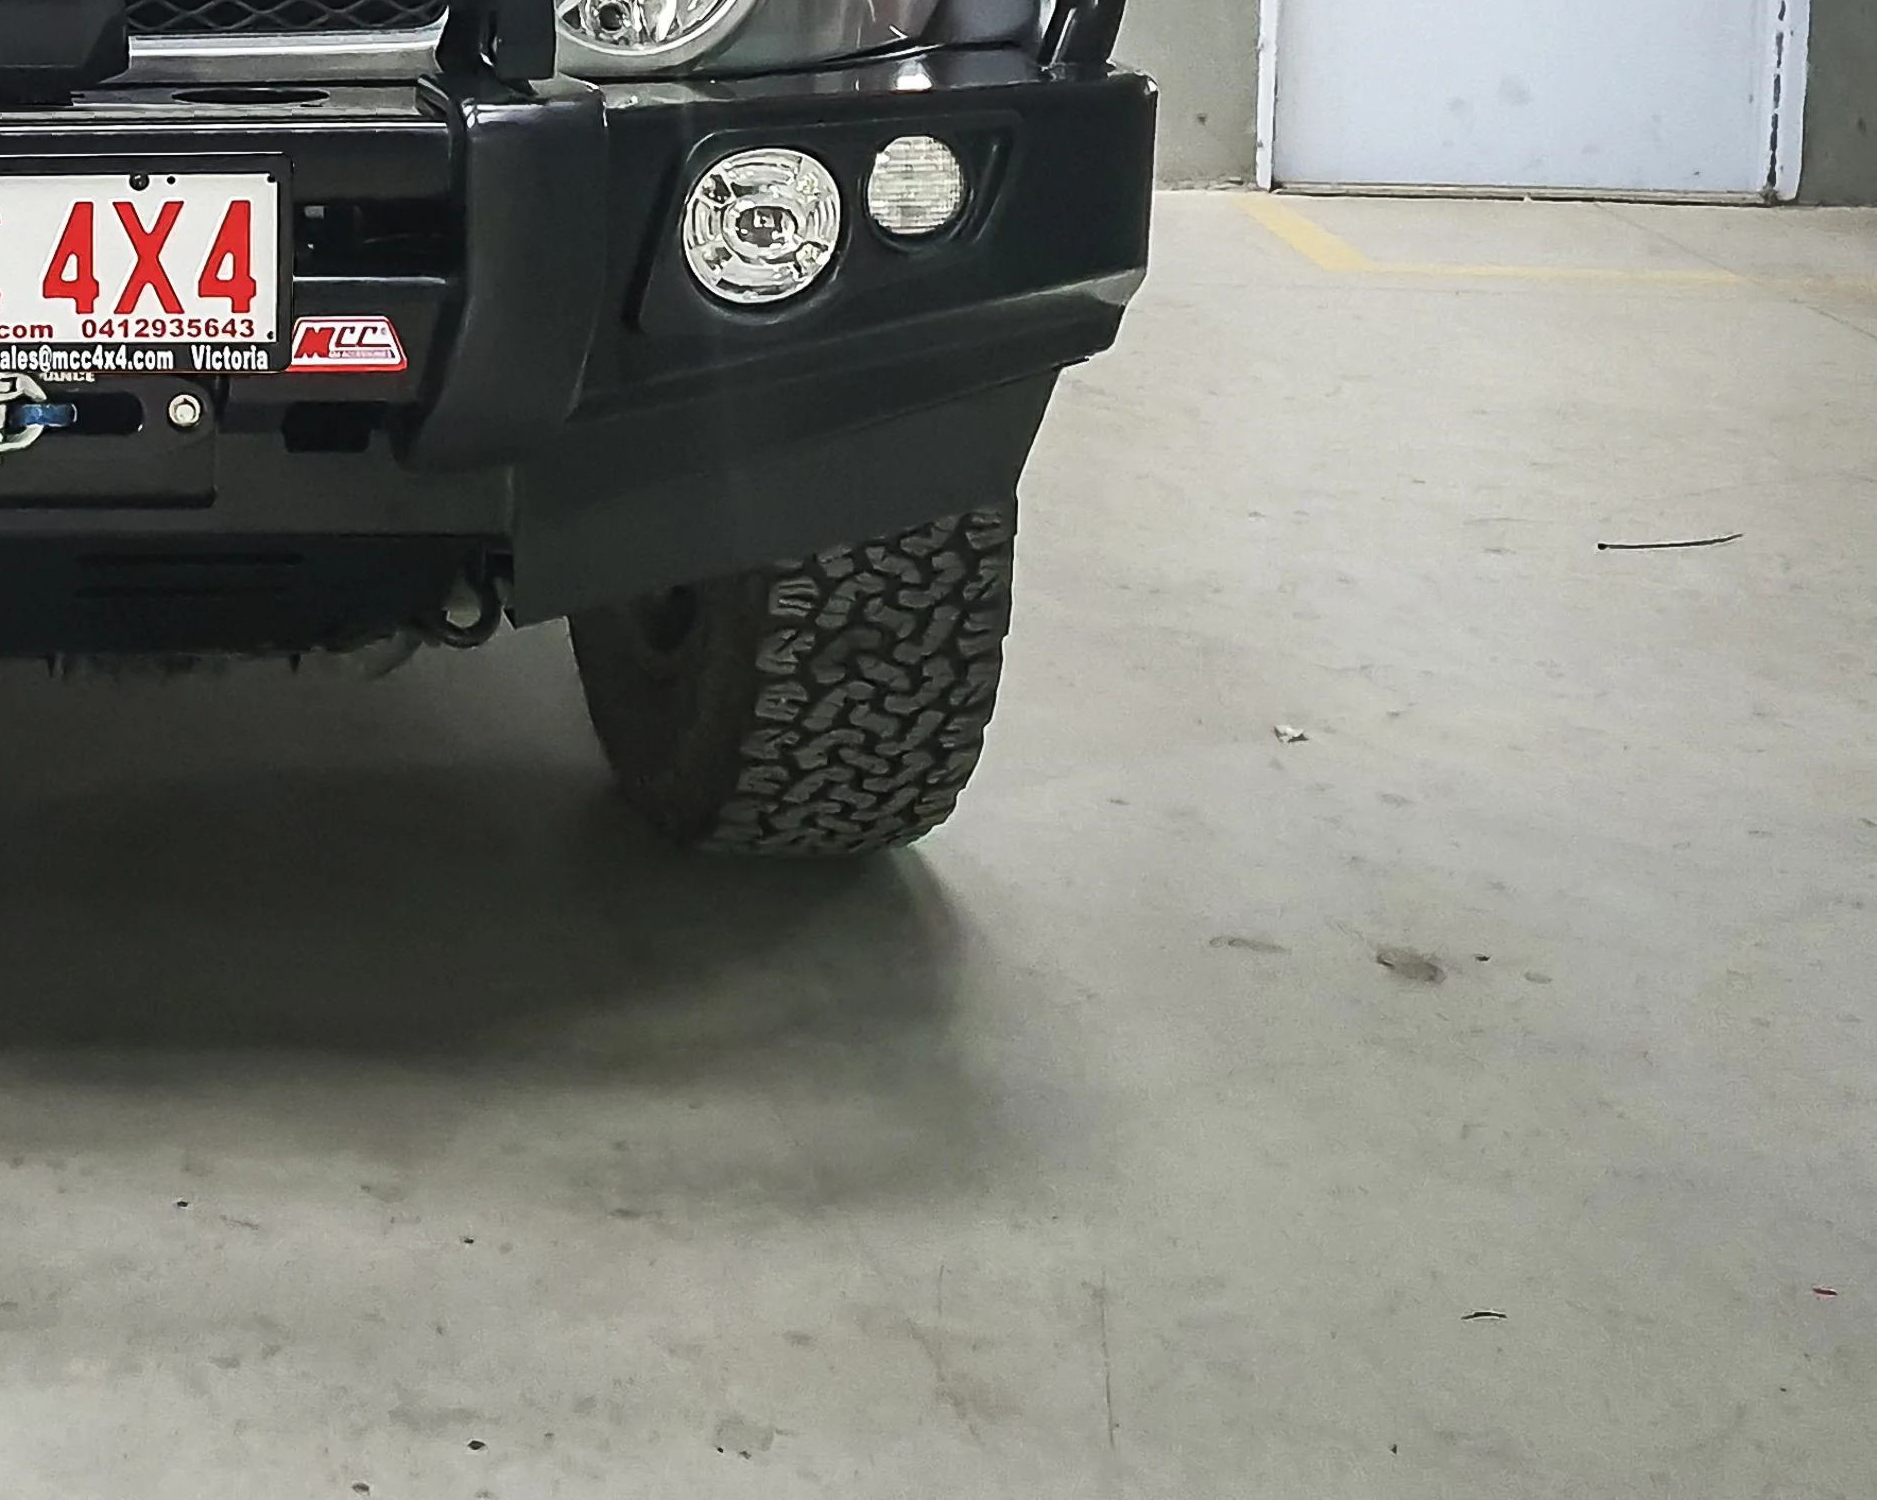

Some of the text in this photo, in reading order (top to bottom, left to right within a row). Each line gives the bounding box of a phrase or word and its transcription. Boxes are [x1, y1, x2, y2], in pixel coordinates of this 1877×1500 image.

[42, 200, 257, 316] 4X4
[81, 318, 255, 339] 0412935643
[293, 326, 392, 359] MCC
[190, 344, 269, 371] Victoria
